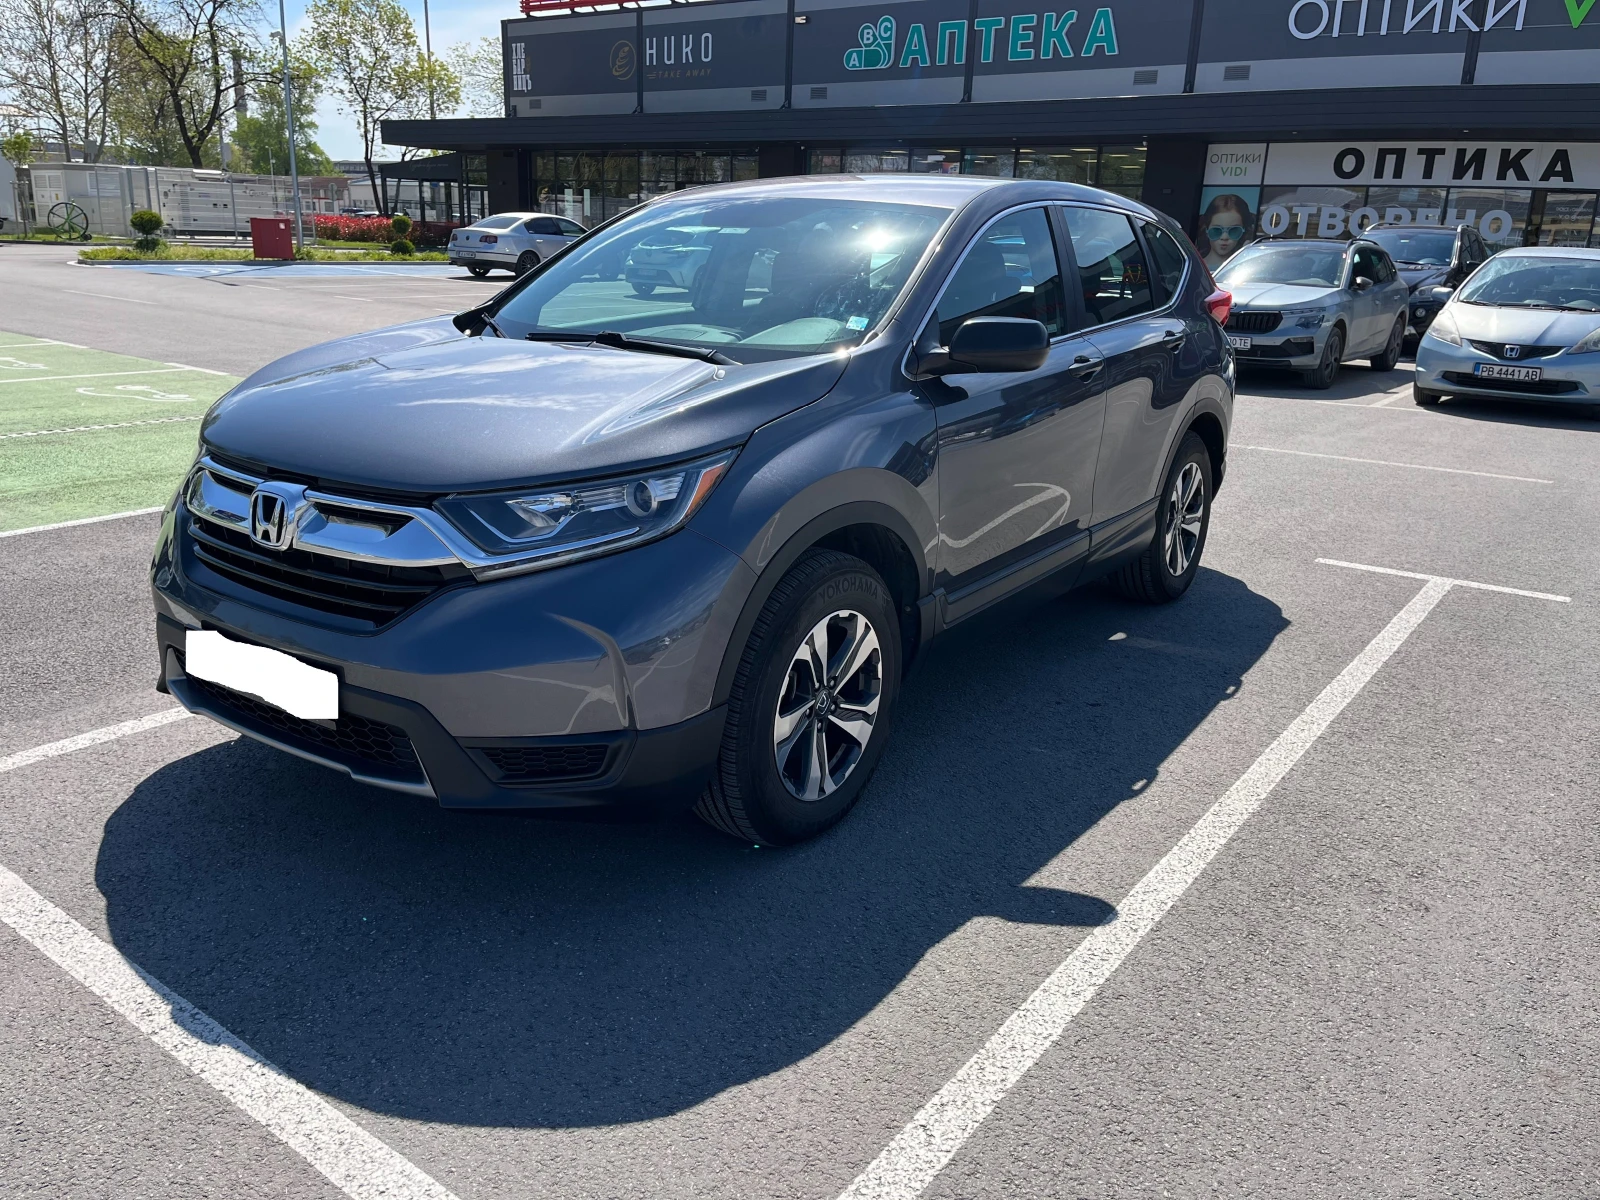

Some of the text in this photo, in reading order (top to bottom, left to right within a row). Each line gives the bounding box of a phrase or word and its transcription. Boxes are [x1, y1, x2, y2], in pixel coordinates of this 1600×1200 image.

[899, 7, 1119, 68] АПТЕКА
[659, 68, 712, 79] TAKE AWAY
[1209, 153, 1262, 164] ОПТИКИ
[1333, 147, 1574, 182] ОПТИКА
[1220, 166, 1248, 177] VIDI
[1239, 338, 1250, 348] TE
[1480, 366, 1538, 380] PB 4441 AB
[818, 576, 879, 605] YOKOHAMA
